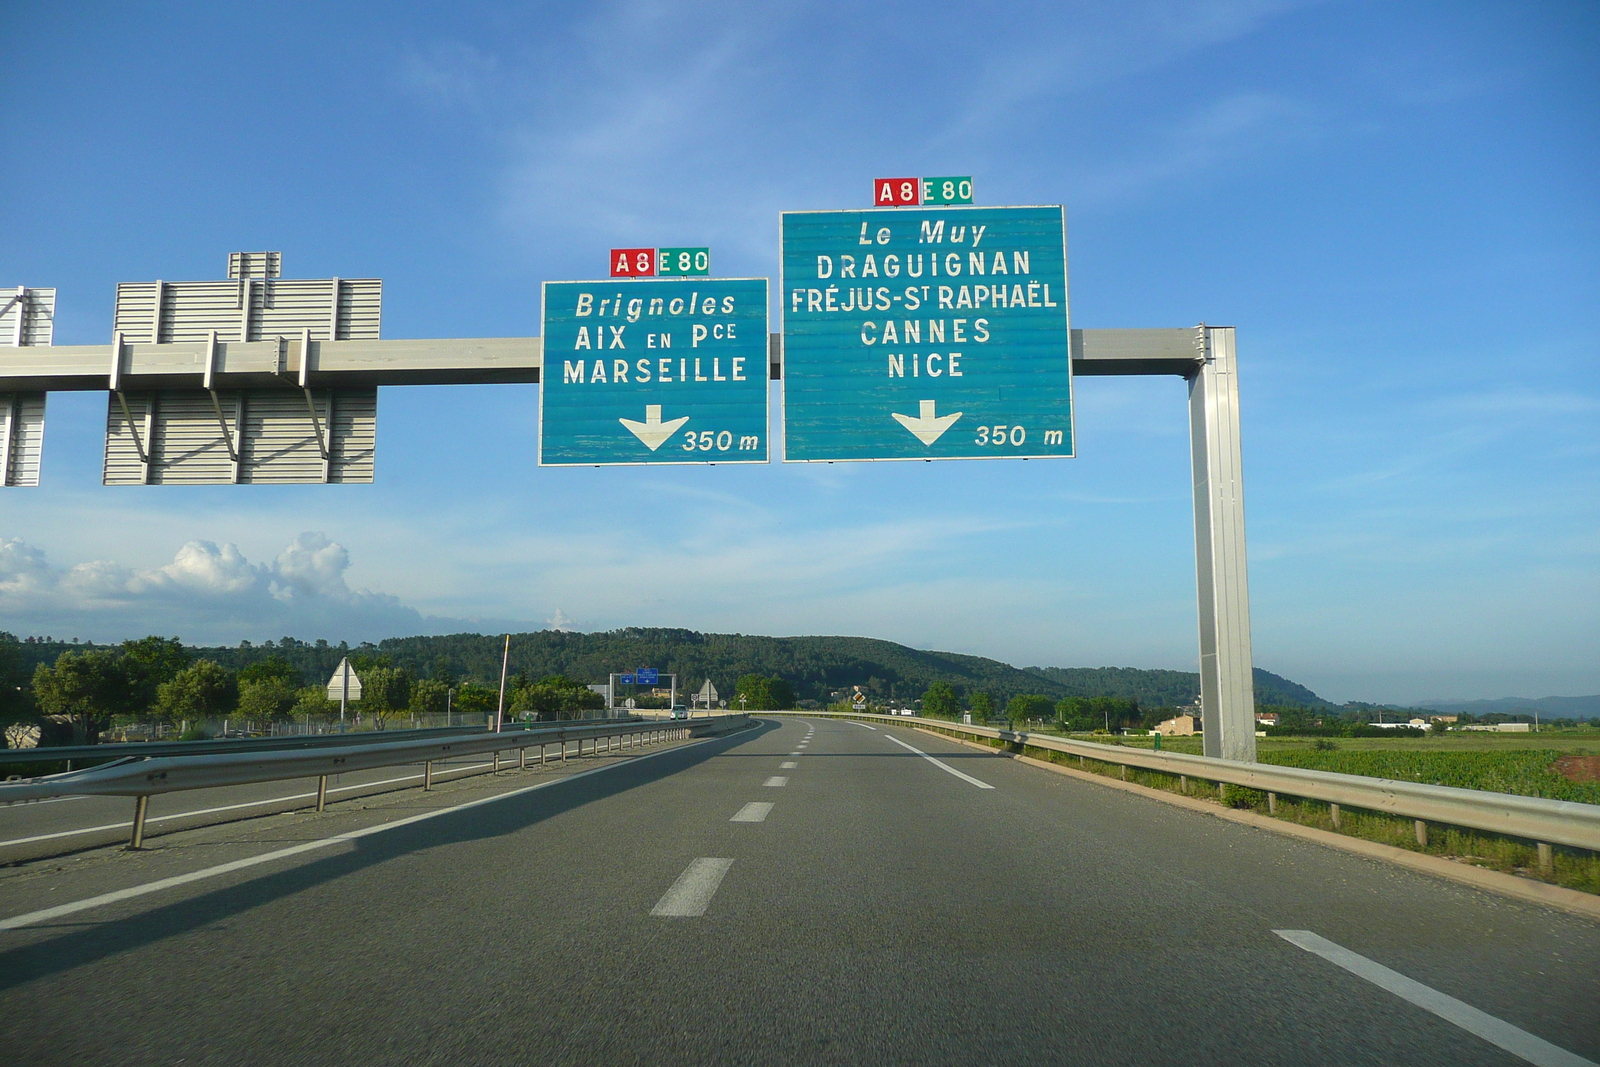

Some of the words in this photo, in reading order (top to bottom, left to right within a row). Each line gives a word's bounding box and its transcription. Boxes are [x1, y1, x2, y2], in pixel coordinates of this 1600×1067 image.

[859, 222, 891, 245] Le
[919, 220, 986, 247] Muy
[817, 251, 1030, 278] DRAGUIGNAN
[575, 292, 735, 323] Brignoles
[938, 280, 1056, 310] RAPHAËL
[575, 326, 626, 350] AIX
[647, 334, 671, 348] EN
[860, 318, 990, 346] CANNES
[564, 357, 746, 384] MARSEILLE
[888, 352, 963, 378] NICE
[682, 431, 732, 451] 350
[739, 435, 758, 450] m
[974, 426, 1026, 446] 350
[1044, 430, 1062, 445] m
